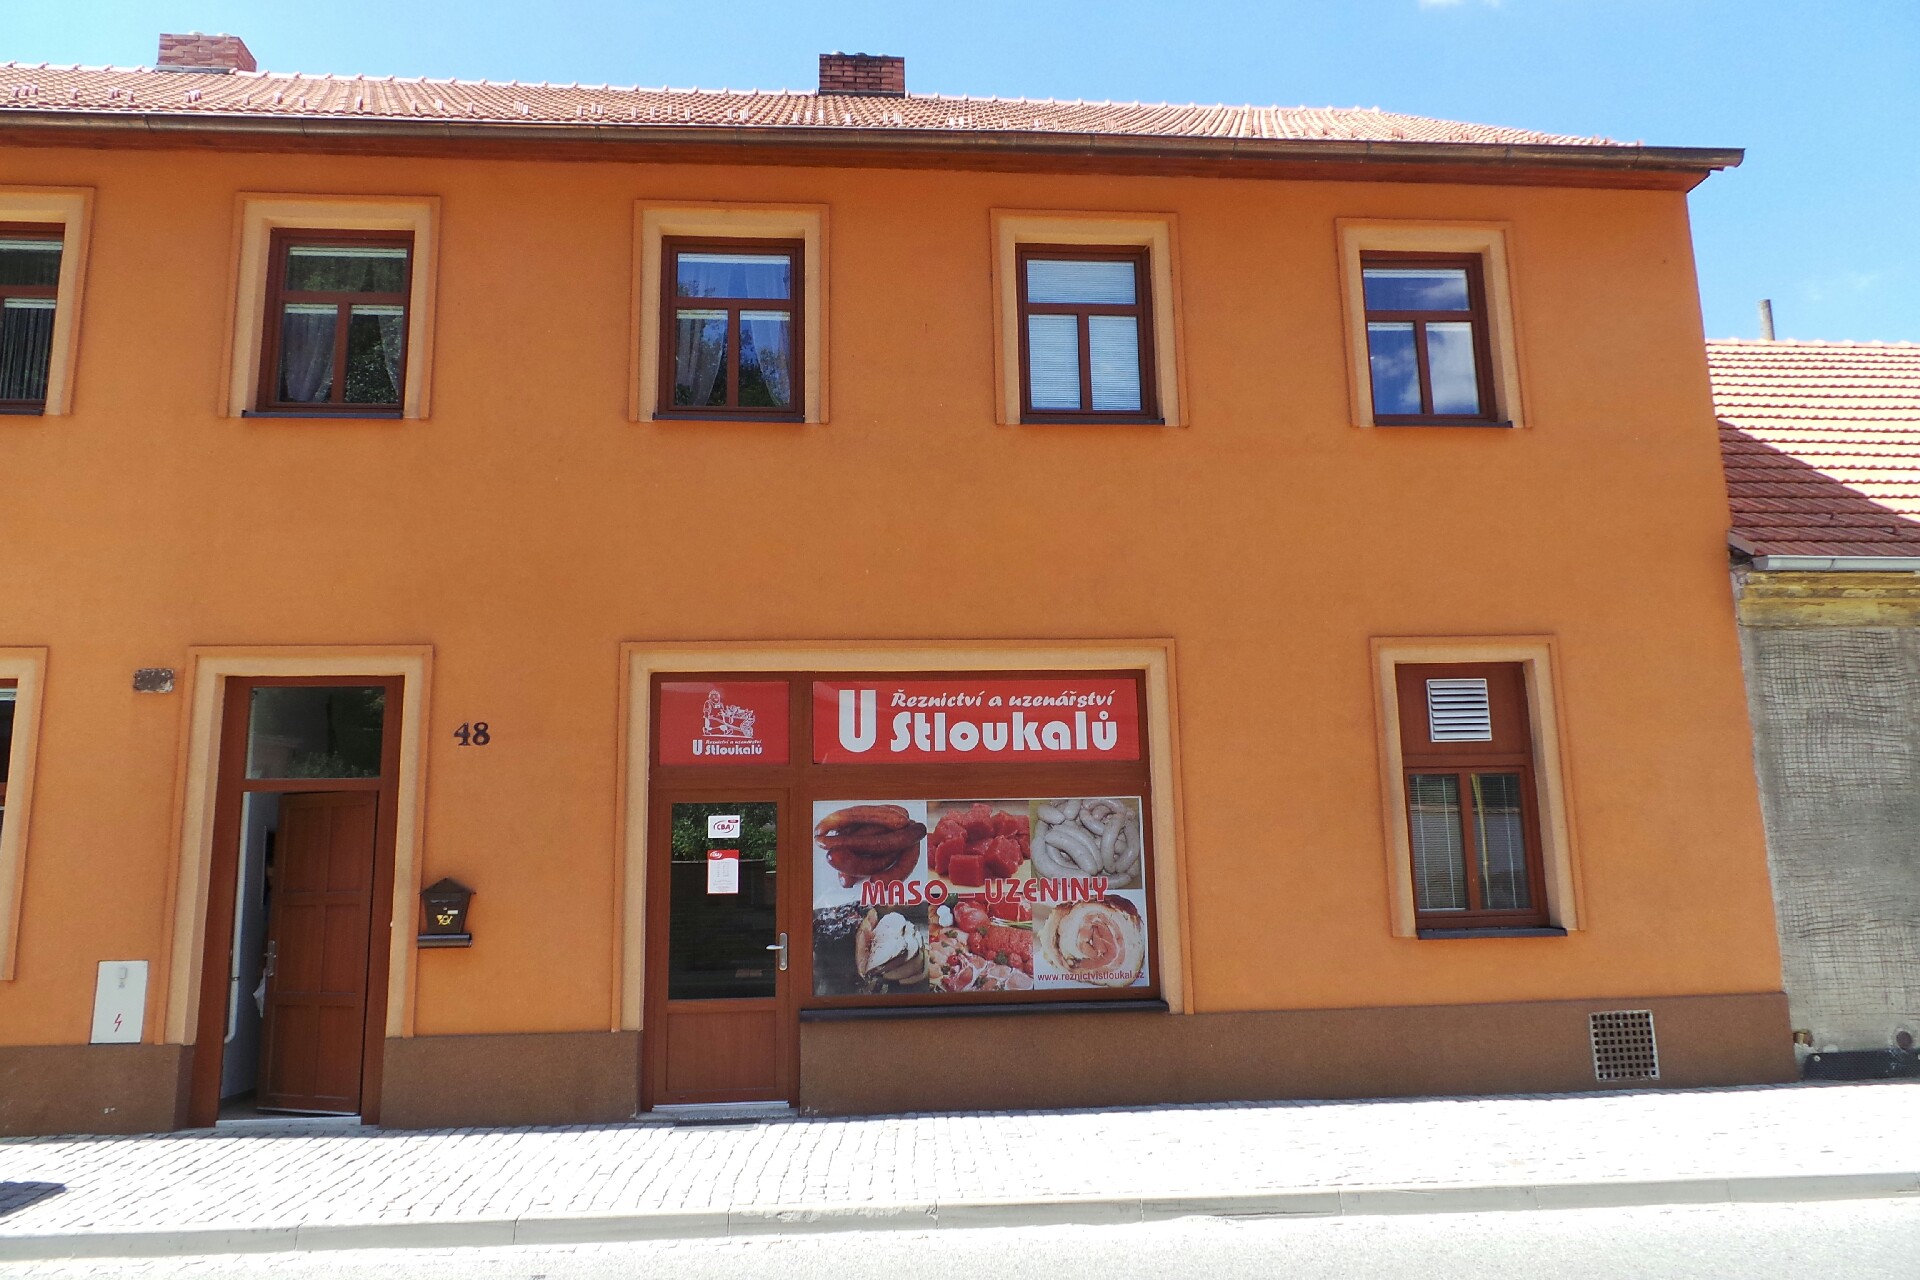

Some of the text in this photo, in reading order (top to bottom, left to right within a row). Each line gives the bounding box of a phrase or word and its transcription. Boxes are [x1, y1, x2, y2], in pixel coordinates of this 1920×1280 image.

[891, 689, 1116, 708] Řeznictví a uzenářství
[453, 721, 491, 746] 48
[838, 689, 1118, 753] U Stloukalů
[692, 739, 703, 756] U
[860, 879, 949, 907] MASO
[984, 876, 1109, 905] UZENINY
